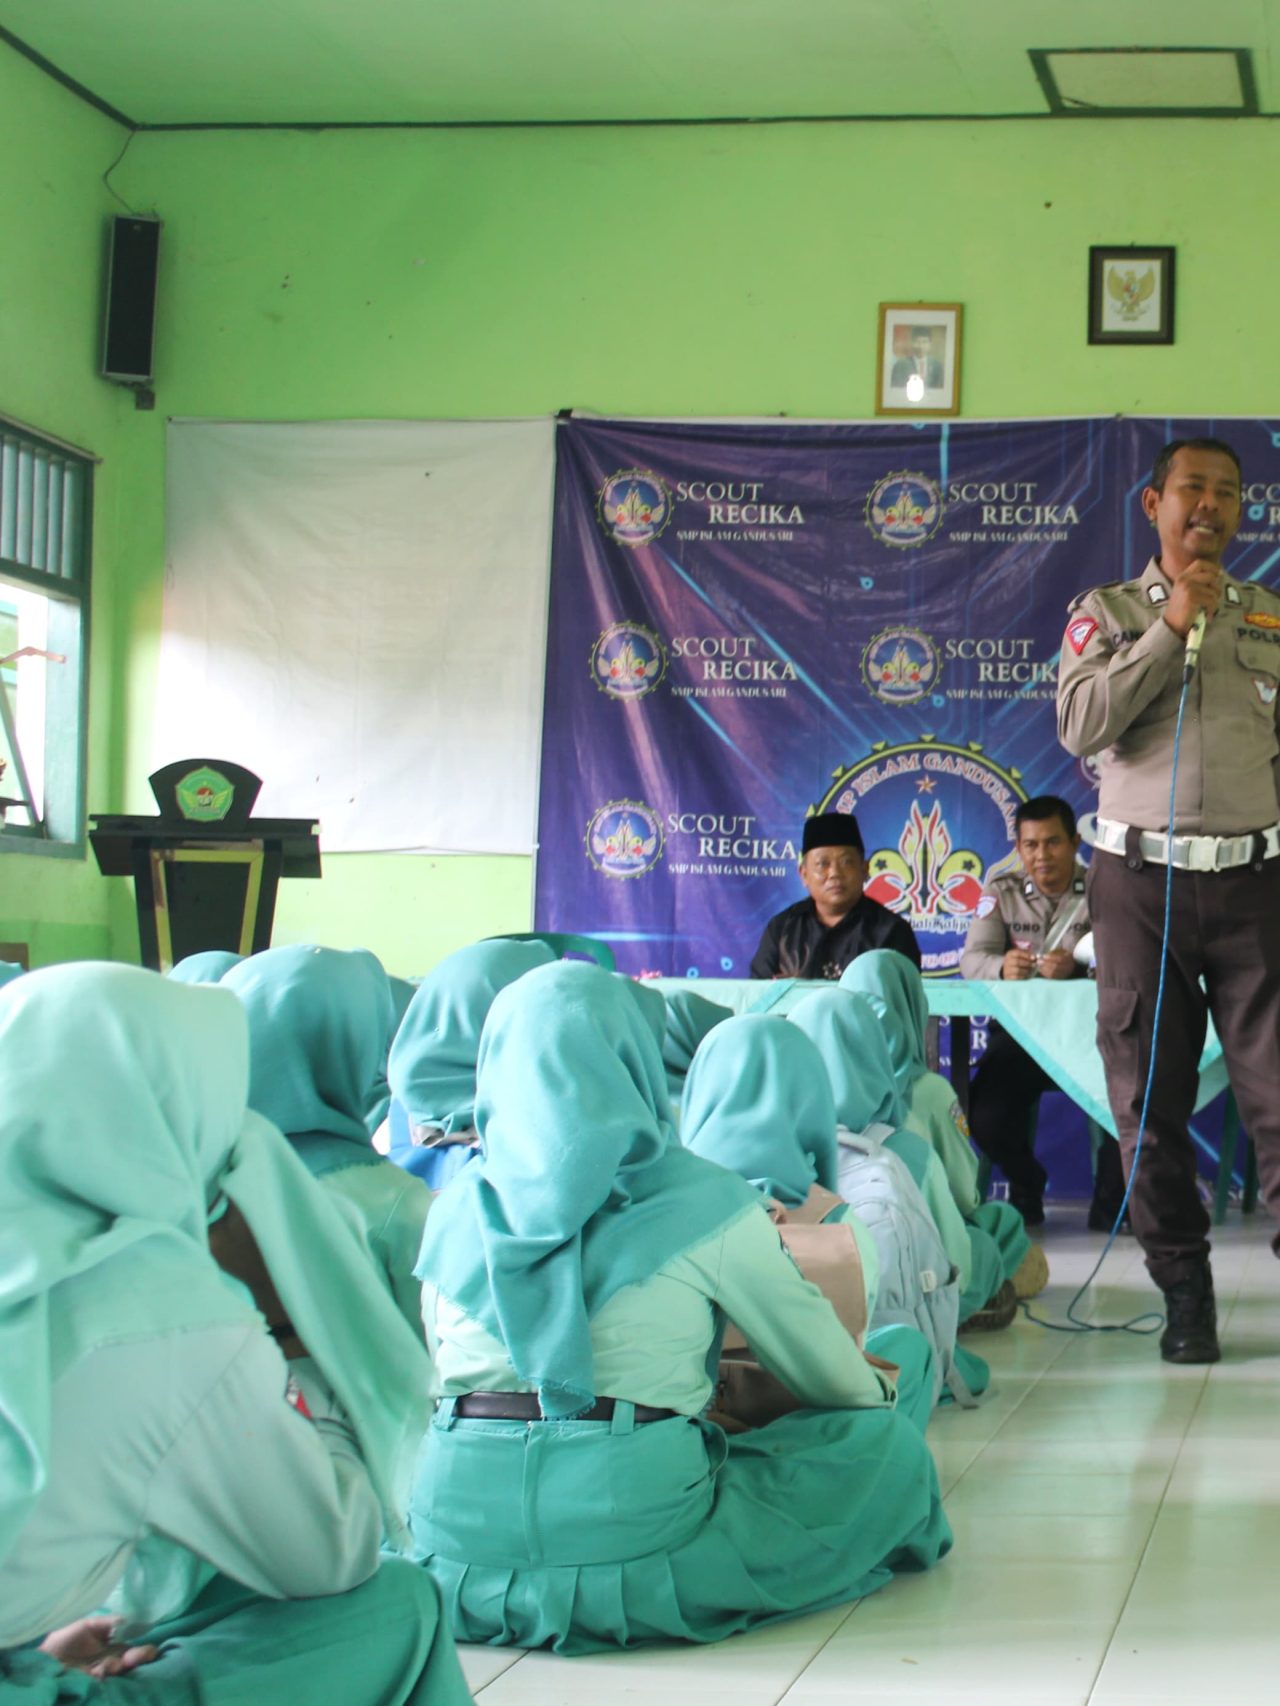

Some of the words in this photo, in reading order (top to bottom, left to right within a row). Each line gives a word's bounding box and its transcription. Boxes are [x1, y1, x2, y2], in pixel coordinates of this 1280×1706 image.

[676, 482, 764, 502] SCOUT
[949, 482, 1038, 502] SCOUT
[708, 504, 805, 524] RECIKA
[981, 505, 1079, 525] RECIKA
[671, 637, 757, 657] SCOUT
[945, 639, 1034, 660] SCOUT
[703, 660, 798, 680] RECIKA
[979, 662, 1058, 682] RECIK
[851, 753, 921, 797] ISLAM
[668, 813, 756, 836] SCOUT
[699, 837, 797, 860] RECIKA
